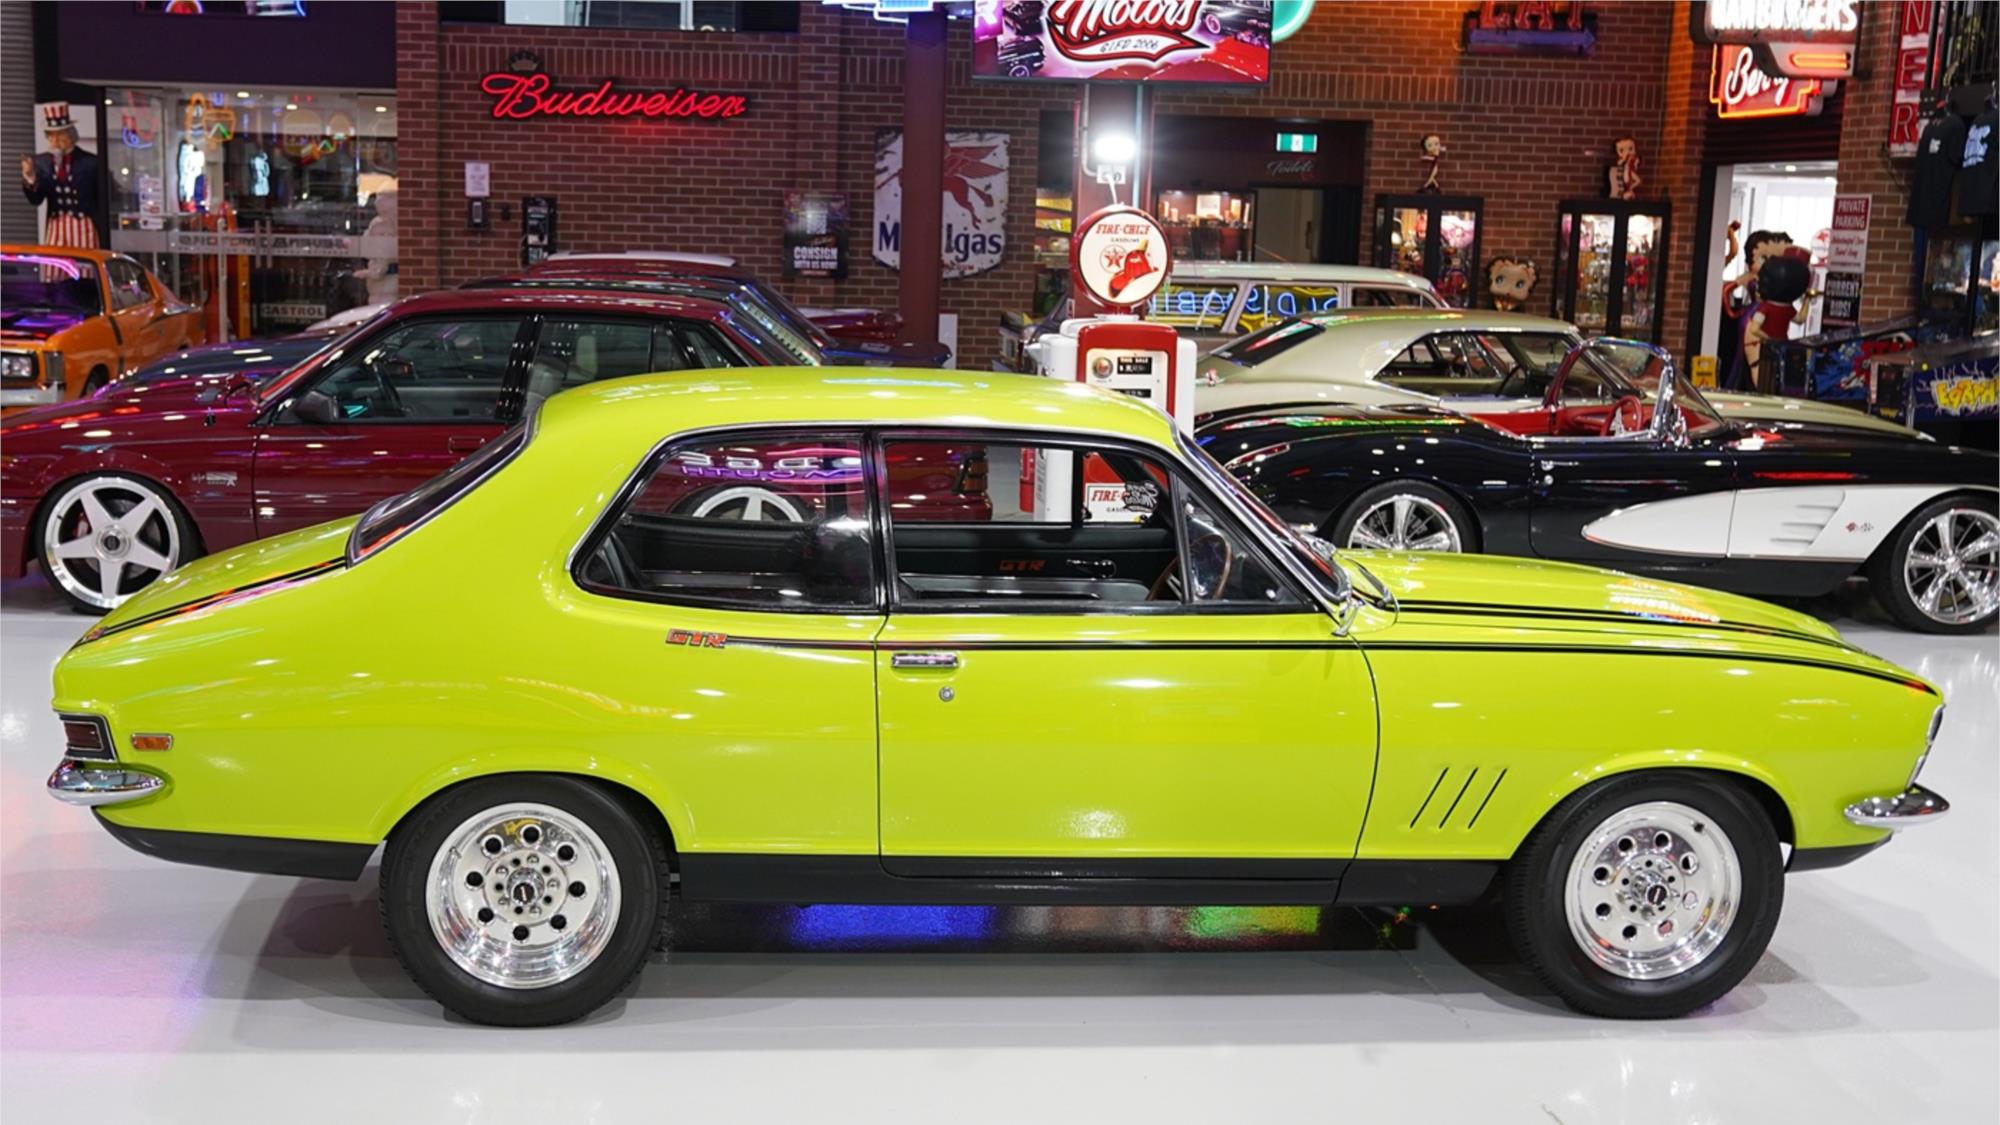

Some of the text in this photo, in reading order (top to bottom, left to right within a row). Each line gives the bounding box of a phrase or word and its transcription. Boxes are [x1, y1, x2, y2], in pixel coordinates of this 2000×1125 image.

[481, 73, 747, 118] Budweiser
[793, 246, 838, 260] CONSIGN
[263, 306, 324, 317] CASTROL
[999, 559, 1047, 572] GTR
[666, 628, 728, 649] GTR
